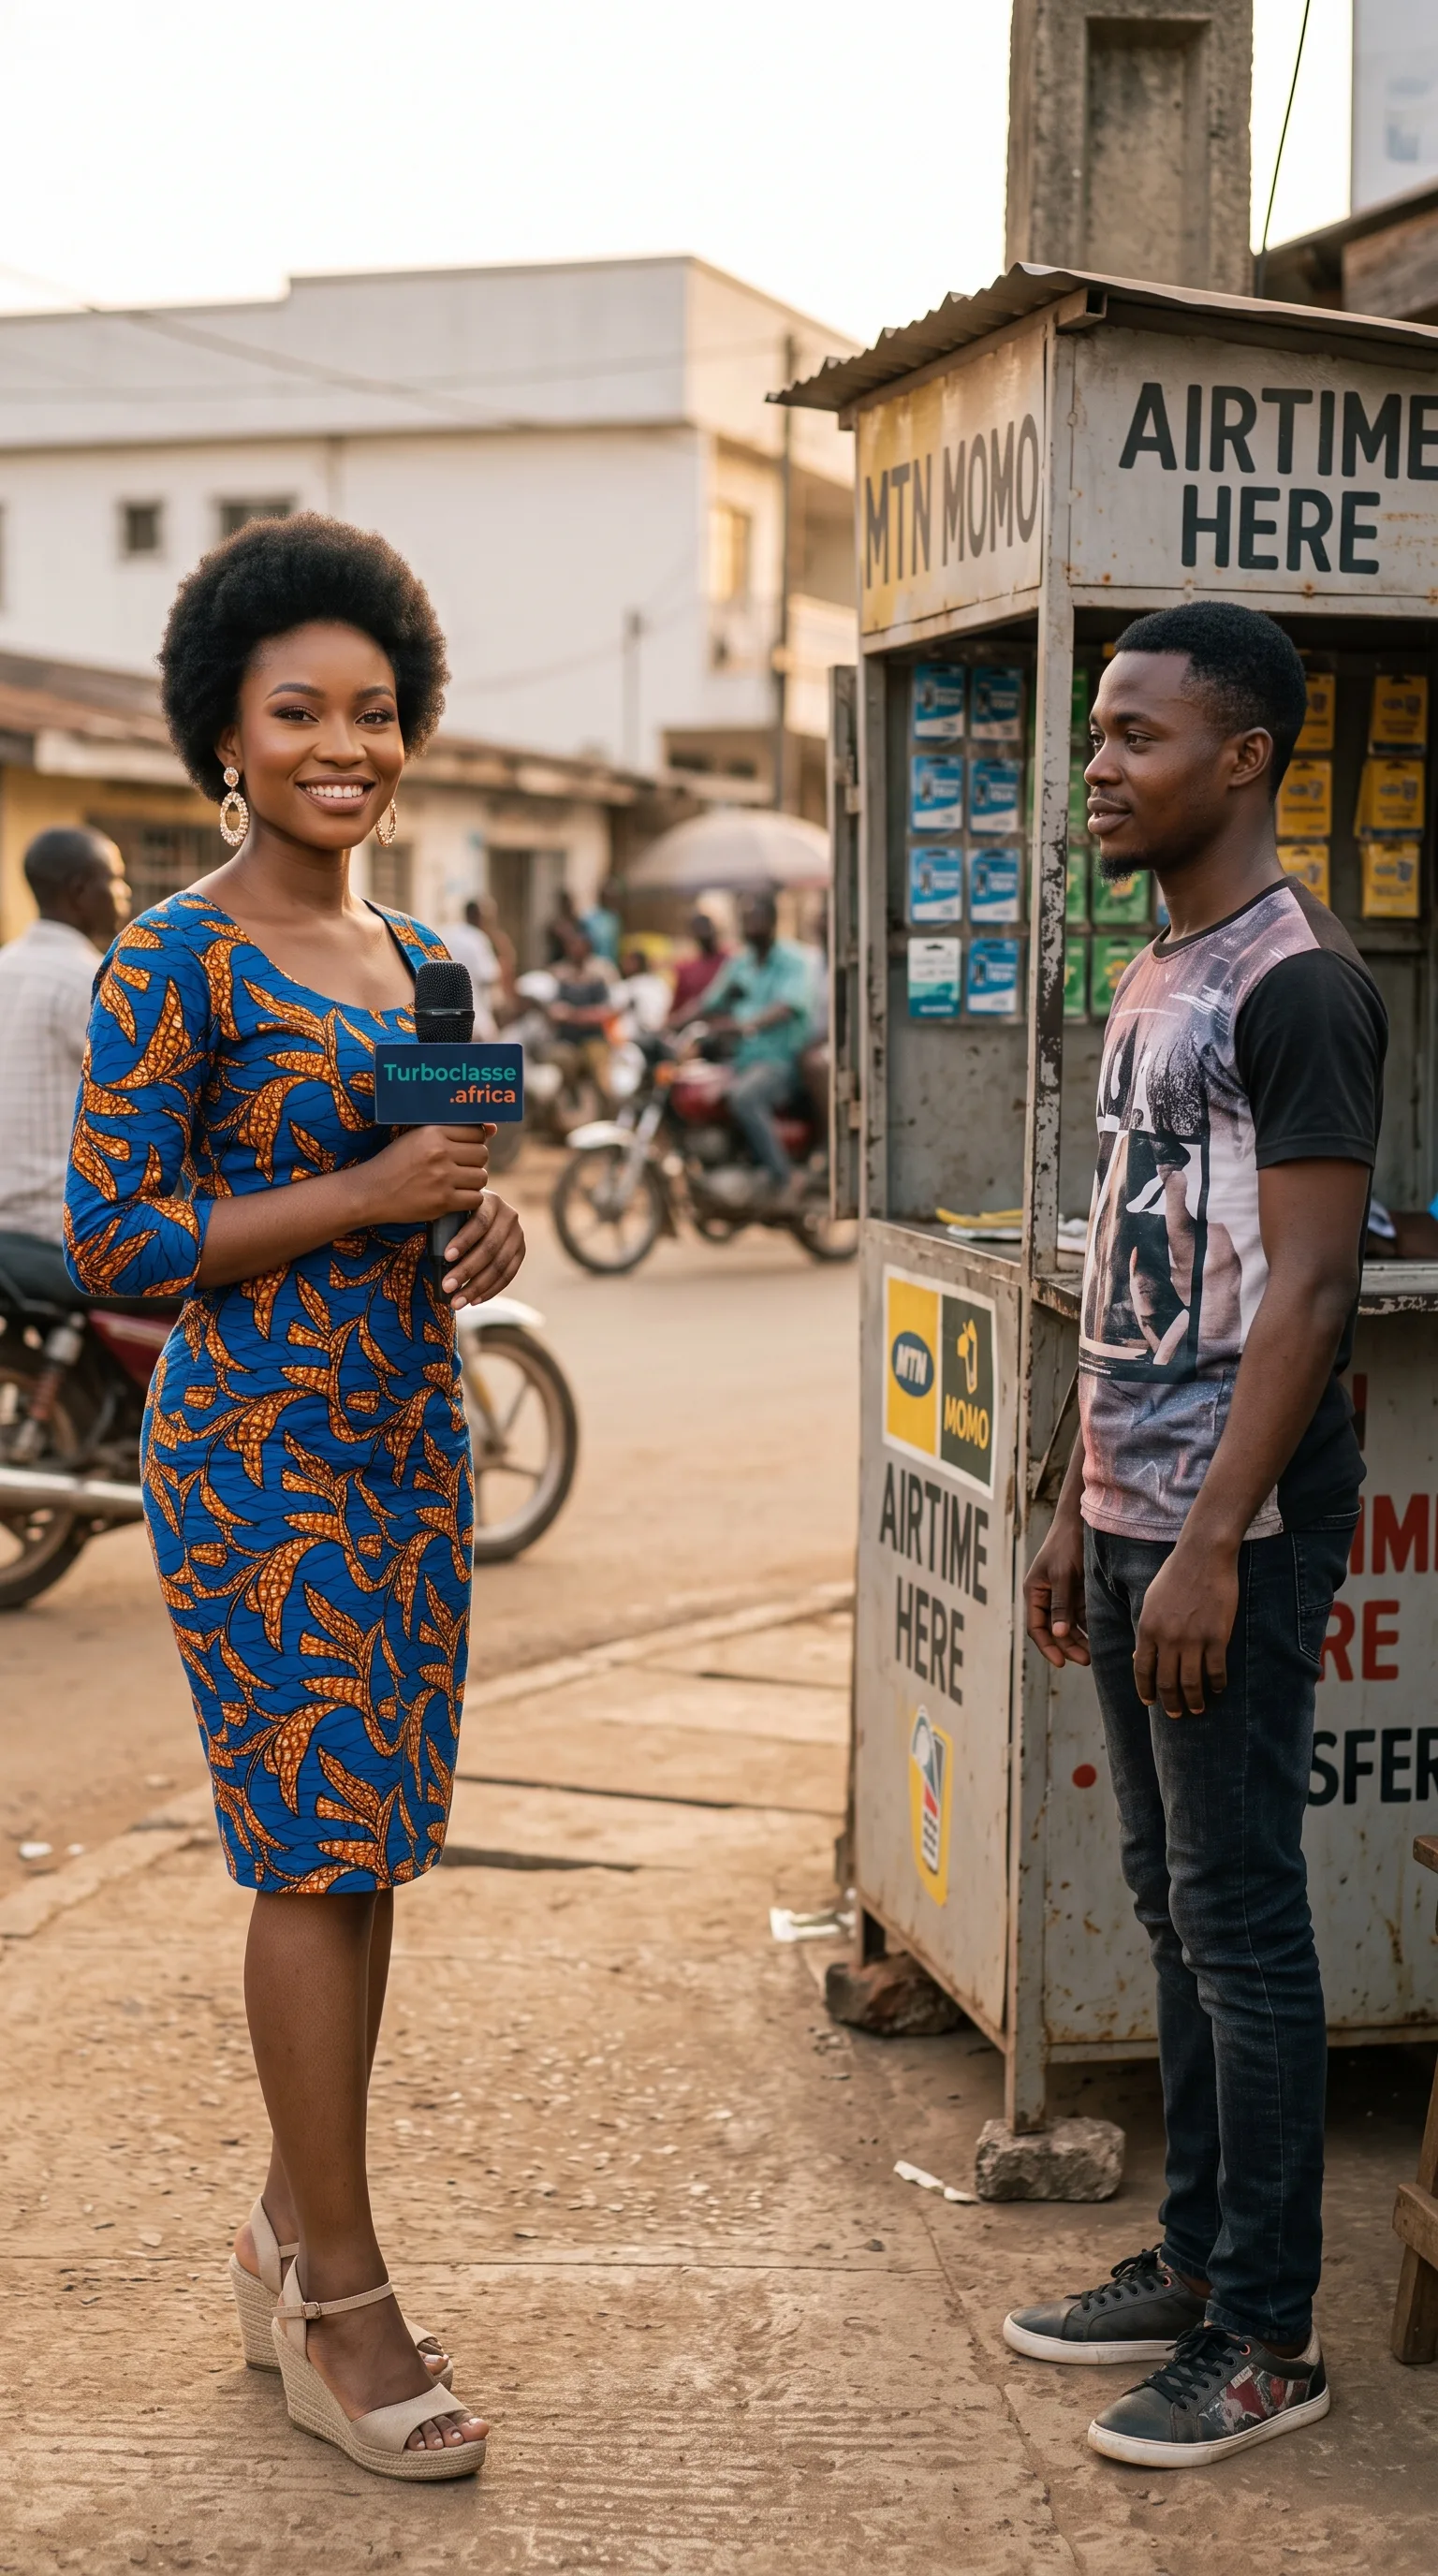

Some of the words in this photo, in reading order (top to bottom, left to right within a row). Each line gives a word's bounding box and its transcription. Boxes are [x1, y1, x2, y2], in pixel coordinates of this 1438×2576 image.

[1119, 382, 1438, 479] AIRTIME
[865, 454, 932, 589] MTN
[942, 414, 1039, 566] MOMO
[1181, 484, 1381, 574] HERE
[383, 1063, 517, 1081] Turboclasse
[449, 1084, 516, 1104] .africa
[895, 1343, 928, 1386] MTN
[944, 1393, 990, 1450] MOMO
[878, 1462, 989, 1605] AIRTIME
[895, 1576, 963, 1706] HERE
[1319, 1600, 1401, 1682] RE
[1308, 1727, 1438, 1808] SFER
